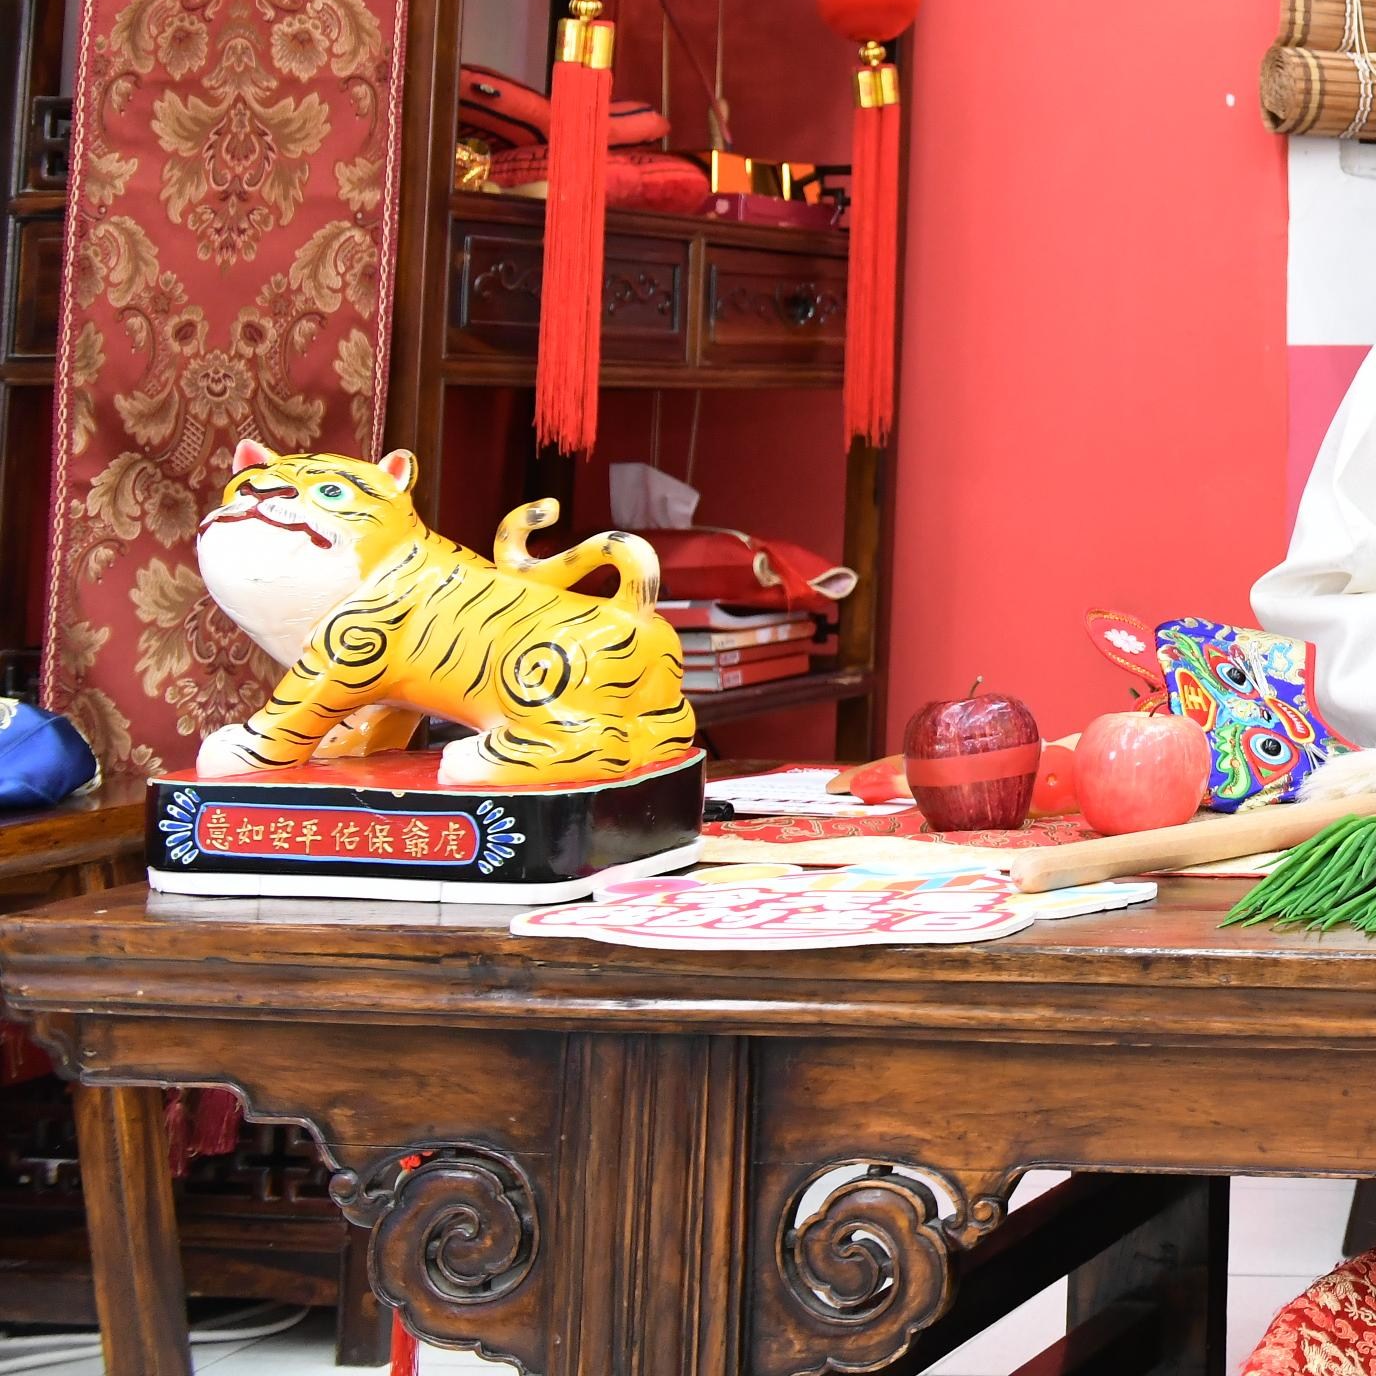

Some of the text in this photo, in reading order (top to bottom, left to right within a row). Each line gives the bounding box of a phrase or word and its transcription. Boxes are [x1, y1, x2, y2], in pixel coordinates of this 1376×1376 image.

[665, 888, 1009, 912] 今天是
[533, 905, 1013, 931] 我的生日
